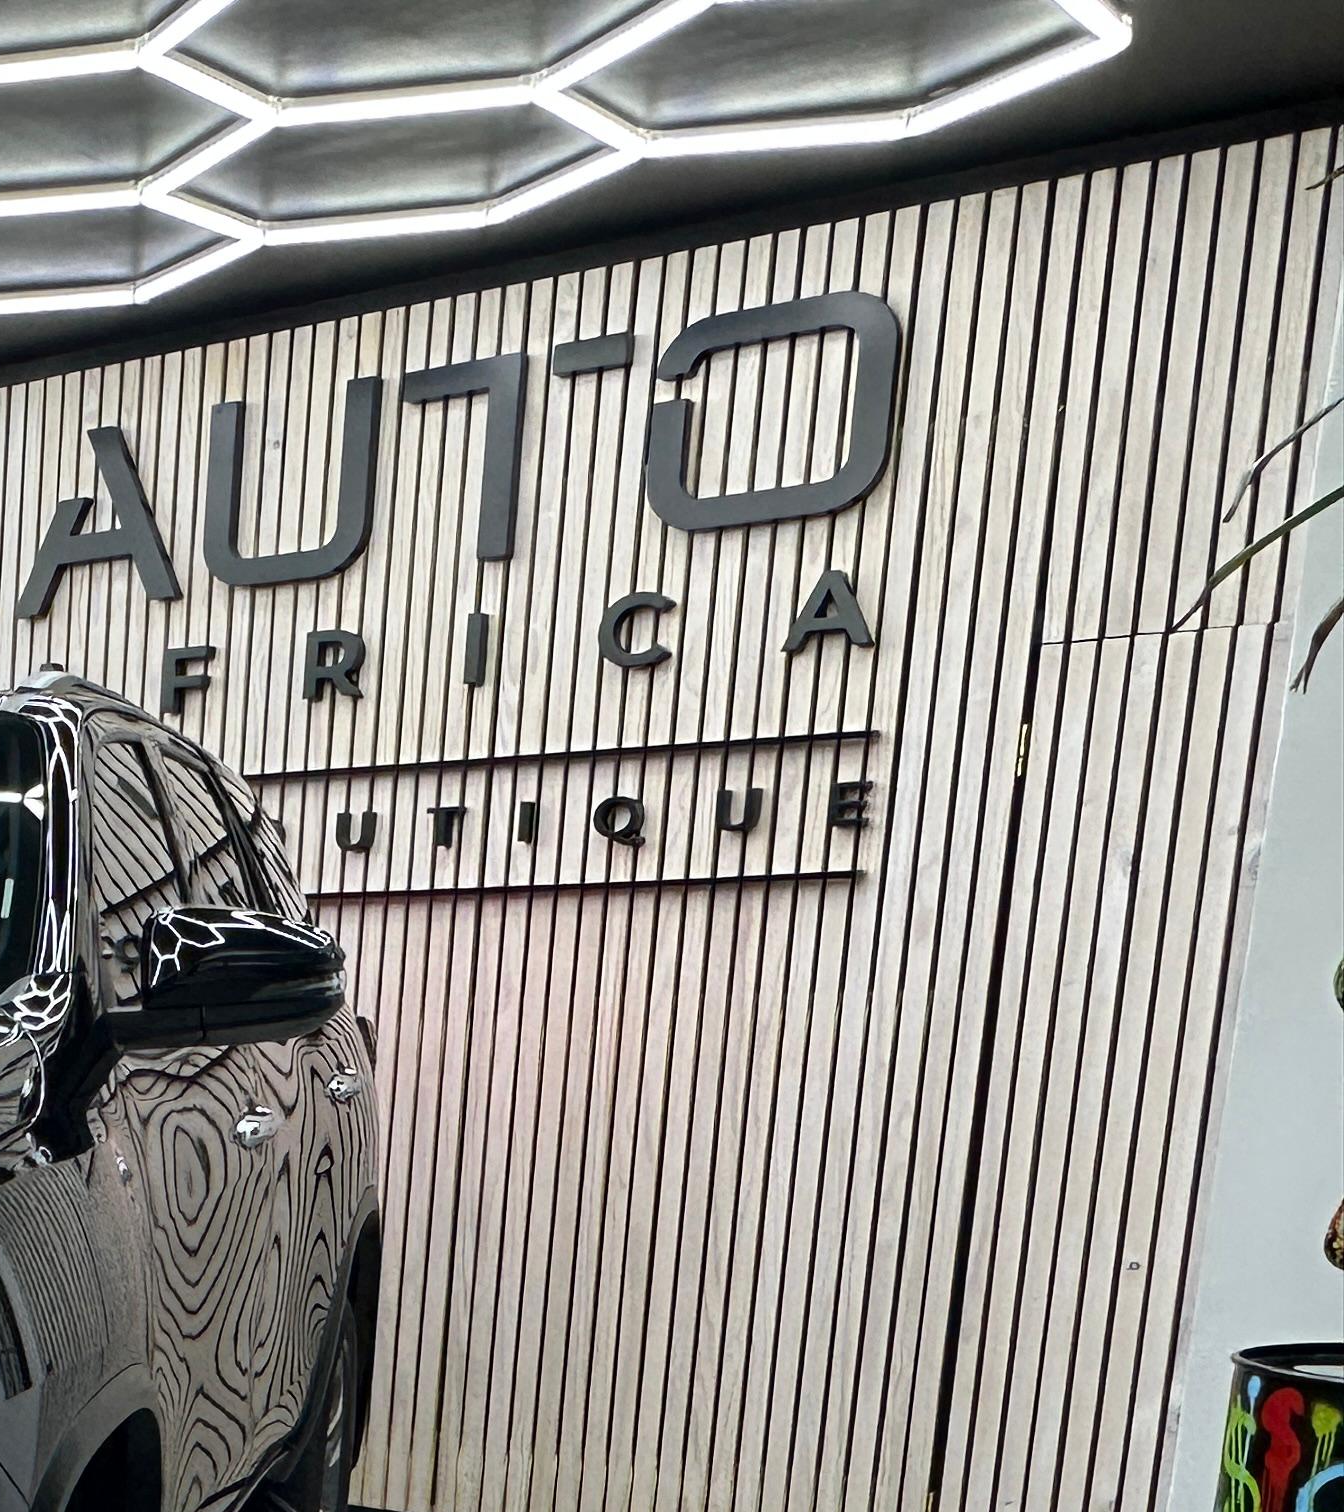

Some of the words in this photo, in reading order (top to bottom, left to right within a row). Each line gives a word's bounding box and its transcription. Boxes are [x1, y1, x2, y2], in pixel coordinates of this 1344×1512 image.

[16, 290, 902, 620] AUTO
[162, 570, 875, 715] FRICA
[275, 779, 874, 853] UTIQUE
